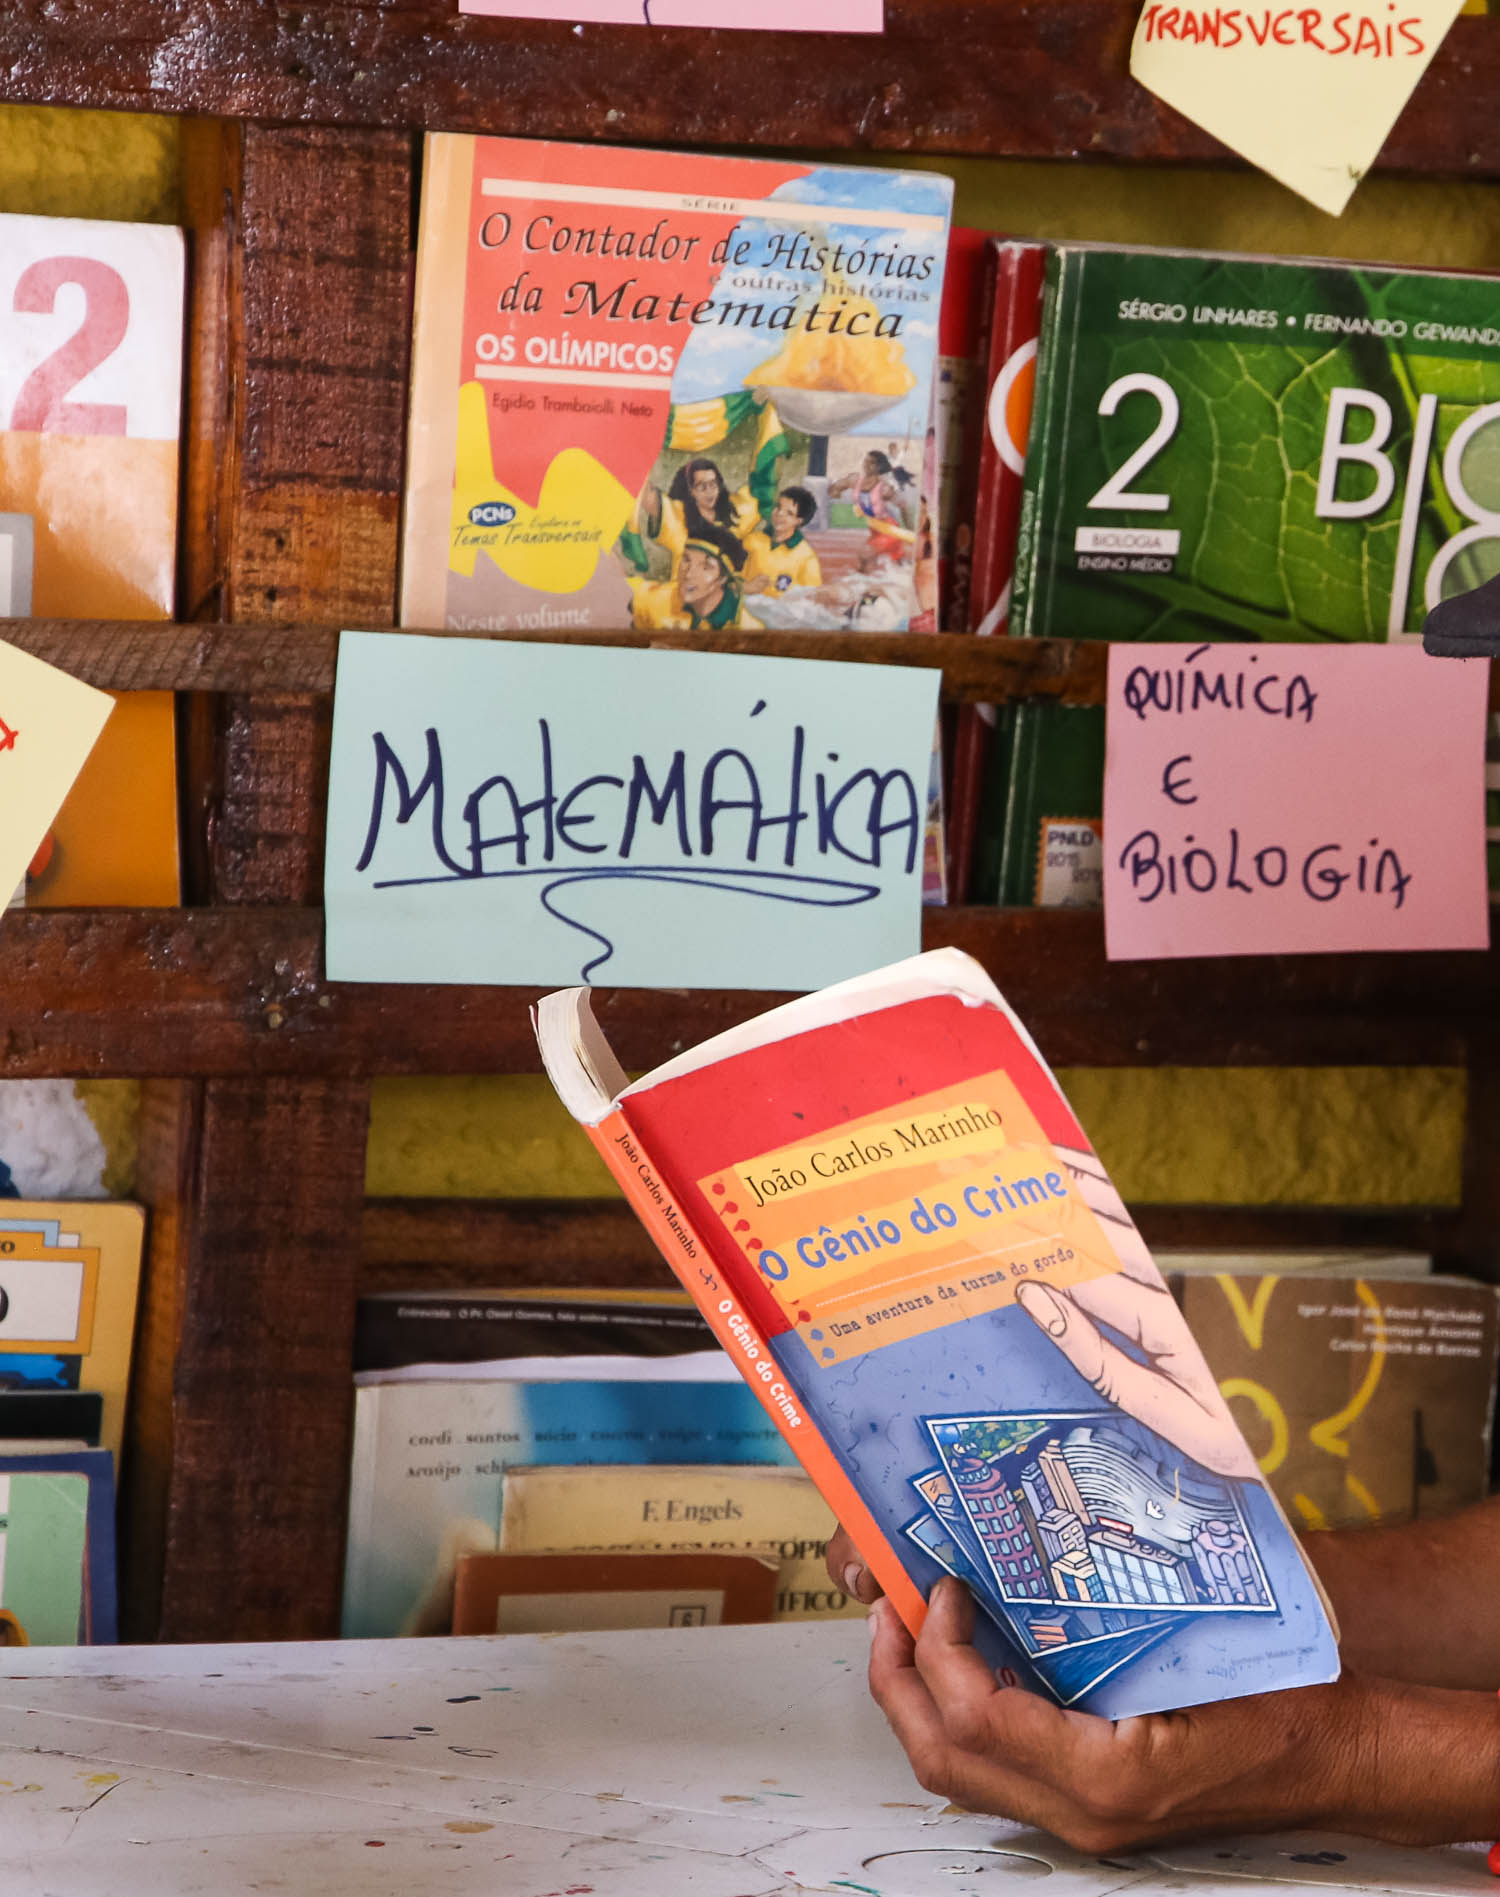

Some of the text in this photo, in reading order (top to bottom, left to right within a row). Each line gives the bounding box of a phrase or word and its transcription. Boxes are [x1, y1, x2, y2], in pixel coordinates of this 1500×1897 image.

[479, 211, 936, 281] O Contador de Histórias
[497, 271, 905, 338] da Matemática
[732, 274, 812, 295] outras
[821, 277, 931, 302] histórias
[1118, 297, 1187, 323] SÉRGIO
[1193, 305, 1279, 328] LINHARES
[1304, 313, 1408, 337] FERNANDO
[475, 331, 673, 371] OS OLÍMPICOS
[621, 402, 653, 418] Neto
[1086, 373, 1180, 511] 2
[453, 522, 602, 547] Temas Transversais
[472, 505, 513, 522] PCNs
[1092, 534, 1163, 549] BIOLOGIA
[1078, 555, 1172, 573] ENSINO MÉDIO
[447, 602, 590, 630] Neste volume
[1124, 645, 1318, 722] QUÍMICA
[1162, 755, 1198, 804] E
[1047, 830, 1094, 847] PNLD
[1119, 828, 1412, 909] BIOLOGIA
[744, 1105, 1004, 1208] João Carlos Marinho
[615, 1132, 698, 1260] João Carlos Marinho
[759, 1171, 1068, 1281] O Gênio do Crime
[829, 1246, 1075, 1339] Uma aventura da turma do gordo
[718, 1299, 802, 1428] O Gênio do Crime
[667, 1499, 742, 1525] Engels
